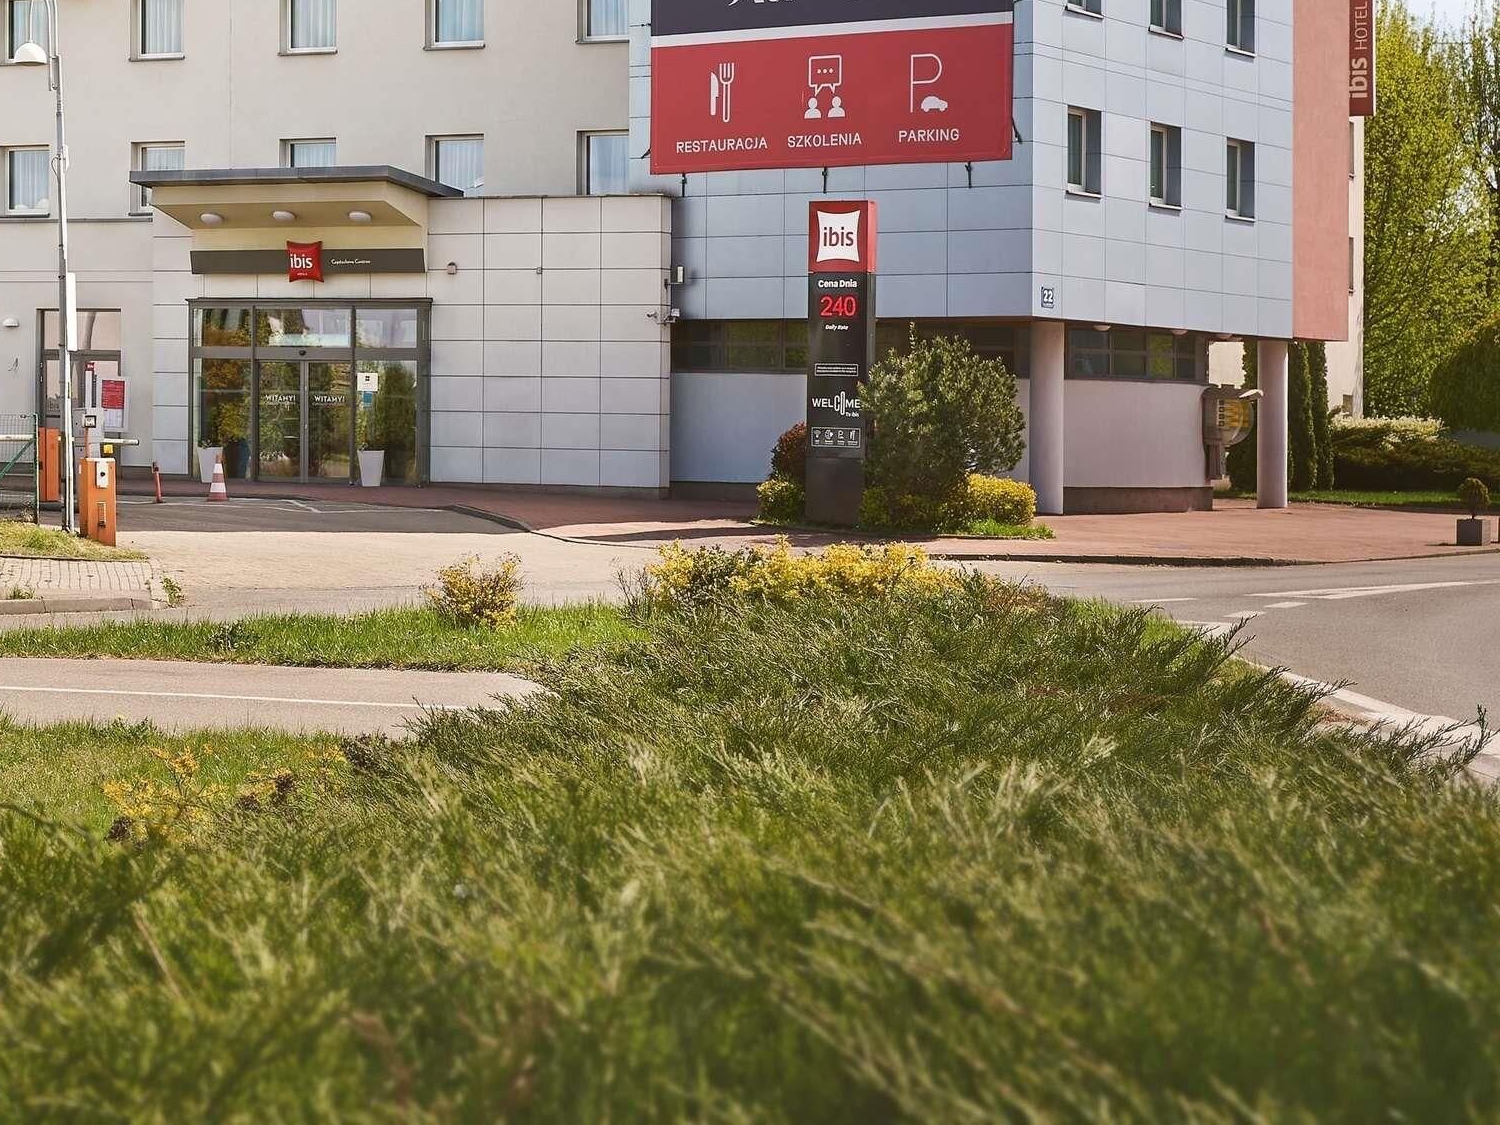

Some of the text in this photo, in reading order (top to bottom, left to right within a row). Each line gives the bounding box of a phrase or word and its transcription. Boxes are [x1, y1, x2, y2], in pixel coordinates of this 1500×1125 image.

[1349, 1, 1368, 99] ibis HOTEL
[787, 132, 863, 149] SZKOLENIA
[898, 128, 961, 143] PARKING
[675, 137, 769, 154] RESTAURACJA
[823, 226, 854, 247] ibis
[290, 253, 313, 269] ibis
[818, 278, 858, 288] Cena Dnia
[1043, 289, 1053, 303] 22
[820, 295, 857, 316] 240
[314, 394, 346, 403] WITAMY!
[811, 391, 861, 416] WELCOME
